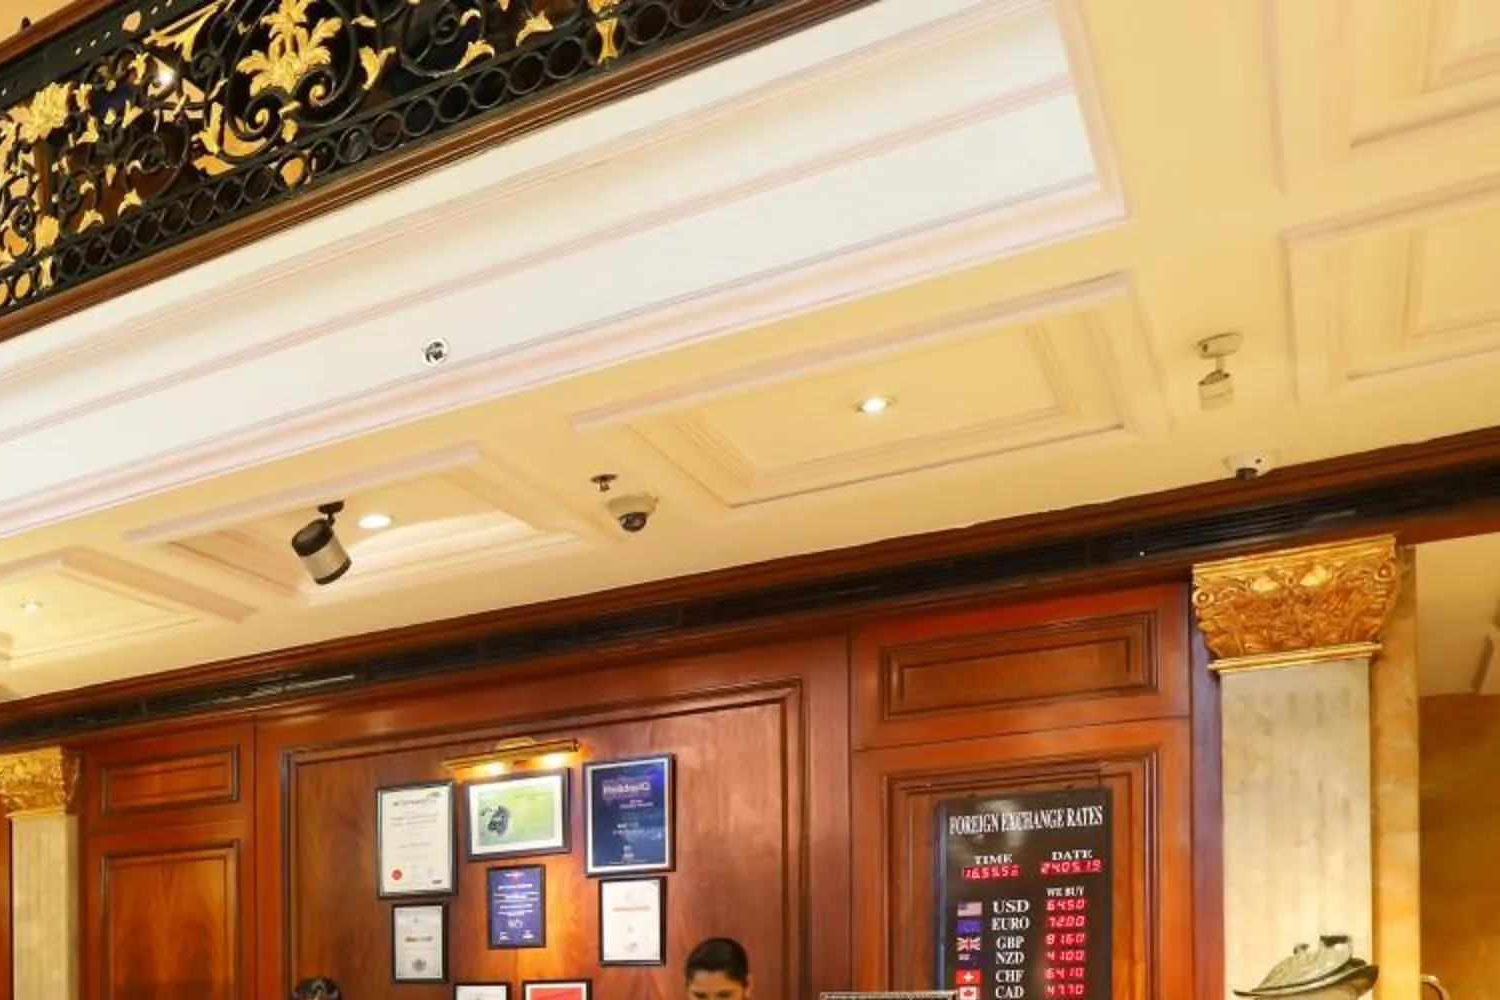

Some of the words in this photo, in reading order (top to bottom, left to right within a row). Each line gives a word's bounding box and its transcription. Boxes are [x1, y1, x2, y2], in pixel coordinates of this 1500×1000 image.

[949, 813, 999, 835] FOREIGN
[1001, 808, 1065, 832] EXCHANGE
[1067, 805, 1103, 827] RATES
[974, 854, 1013, 865] TIME
[1051, 850, 1092, 861] DATE
[1065, 886, 1084, 897] BUY
[993, 899, 1030, 914] USD
[991, 916, 1030, 931] EURO
[995, 935, 1025, 950] GBP
[995, 951, 1025, 965] NZD
[995, 969, 1024, 983] CHF
[995, 985, 1024, 999] CAD
